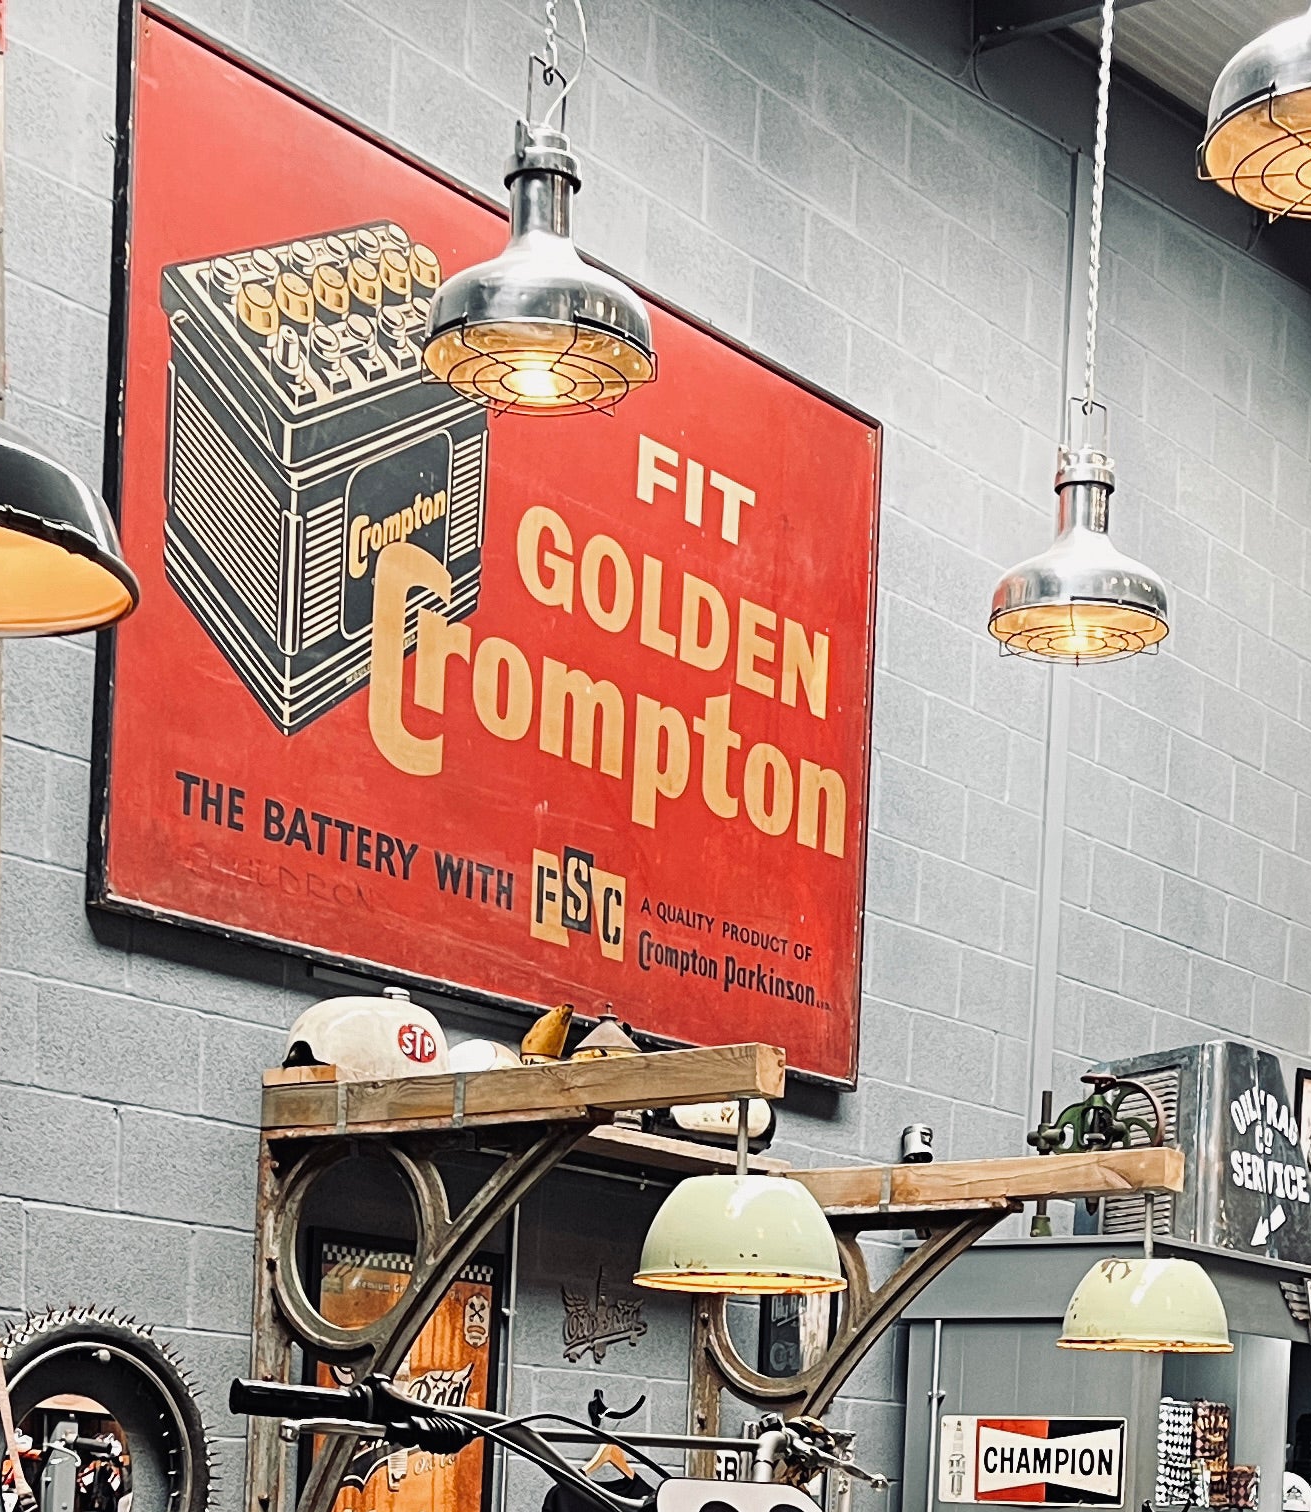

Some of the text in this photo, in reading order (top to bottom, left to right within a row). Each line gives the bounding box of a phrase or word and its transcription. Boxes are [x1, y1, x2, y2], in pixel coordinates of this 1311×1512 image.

[636, 433, 756, 546] FIT
[348, 490, 447, 579] Crompton
[516, 505, 830, 721] GOLDEN
[367, 541, 846, 859] Crompton
[176, 770, 622, 946] THE BATTERY WITH FSC
[640, 897, 813, 962] A QUALITY PRODUCT OF
[639, 930, 718, 981] Crompton
[723, 955, 816, 1007] Parkinson
[401, 1025, 436, 1061] STP
[1230, 1086, 1299, 1147] OILY RAG
[1230, 1150, 1311, 1204] SERVICE
[983, 1446, 1113, 1476] CHAMPION
